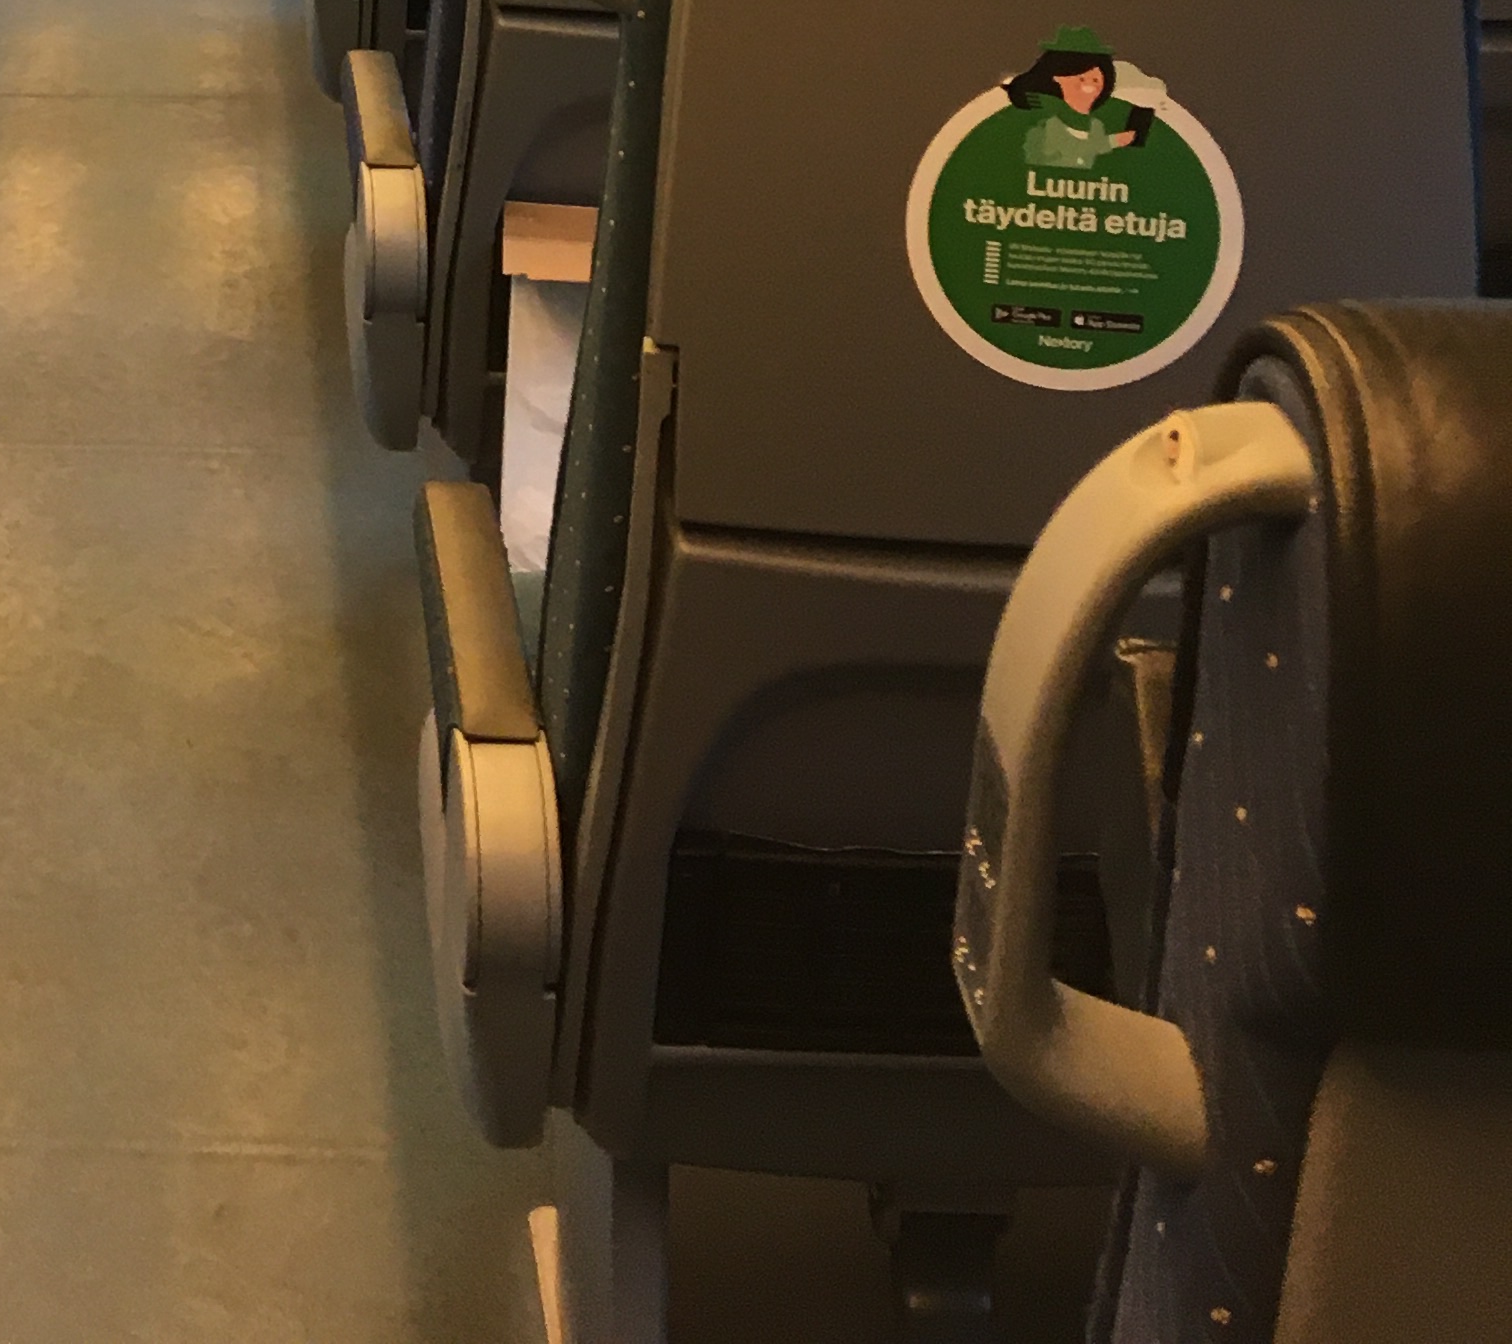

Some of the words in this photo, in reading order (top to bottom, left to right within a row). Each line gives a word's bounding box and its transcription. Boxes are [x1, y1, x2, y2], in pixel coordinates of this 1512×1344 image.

[1026, 170, 1129, 204] Luurin
[963, 197, 1098, 233] täydeltä
[1104, 211, 1187, 243] etuja
